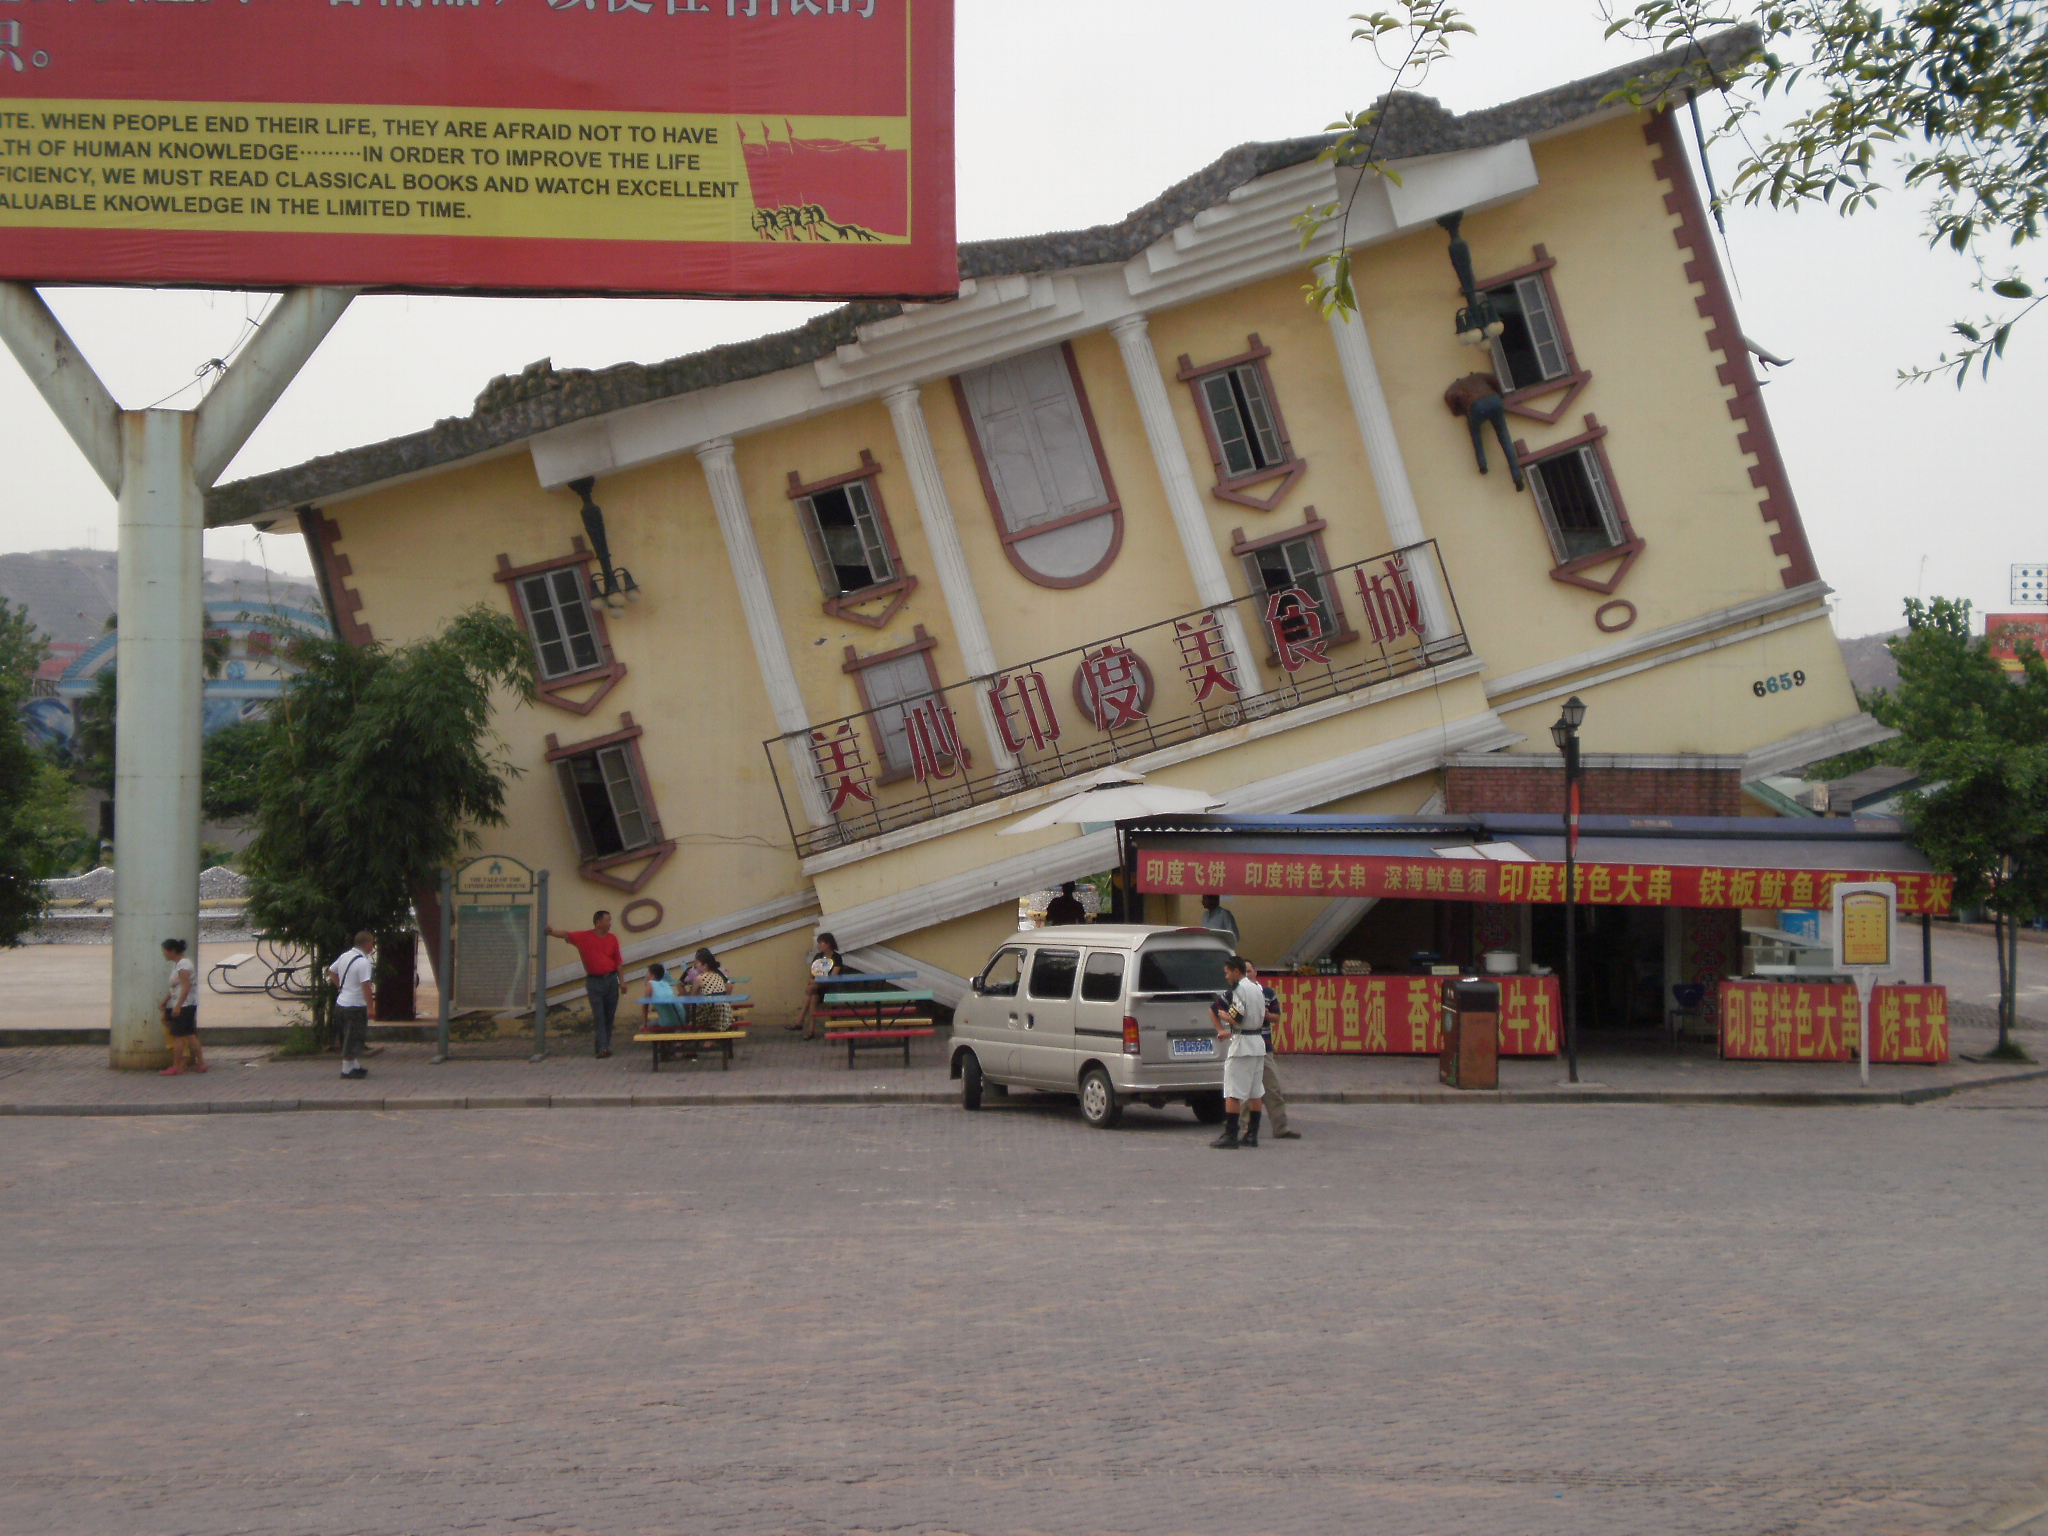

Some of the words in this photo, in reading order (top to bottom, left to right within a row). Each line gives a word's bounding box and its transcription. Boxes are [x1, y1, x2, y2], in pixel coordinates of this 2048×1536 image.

[41, 112, 106, 131] WHEN
[113, 113, 199, 133] PEOPLE
[205, 115, 250, 134] END
[255, 116, 320, 135] THEIR
[326, 117, 377, 139] LIFE,
[382, 118, 440, 137] THEY
[443, 119, 488, 139] ARE
[492, 121, 572, 141] AFRAID
[578, 124, 623, 142] NOT
[628, 125, 657, 143] TO
[663, 126, 719, 145] HAVE
[37, 139, 67, 157] OF
[74, 141, 152, 159] HUMAN
[389, 146, 466, 165] ORDER
[471, 148, 500, 166] TO
[506, 149, 602, 169] IMPROVE
[608, 151, 650, 170] THE
[656, 153, 701, 171] LIFE
[102, 167, 136, 185] WE
[143, 168, 203, 187] MUST
[209, 169, 269, 188] READ
[275, 170, 397, 190] CLASSICAL
[402, 173, 479, 193] BOOKS
[483, 175, 530, 193] AND
[535, 176, 610, 196] WATCH
[616, 178, 740, 199] EXCELLENT
[103, 194, 244, 214] KNOWLEDGE
[250, 197, 271, 215] IN
[277, 197, 320, 216] THE
[326, 198, 411, 217] LIMITED
[416, 200, 472, 219] TIME.
[808, 556, 1427, 814] 美心印度美食城
[1752, 669, 1807, 698] 6659
[1145, 859, 1227, 887] 印度飞饼
[1244, 861, 1367, 890] 印度特色大串
[1383, 865, 1488, 894] 深海鱿鱼须
[1498, 862, 1672, 905] 印度特色大串
[1727, 984, 1860, 1057] 印度特色大串
[1879, 988, 1947, 1060] 烤玉米
